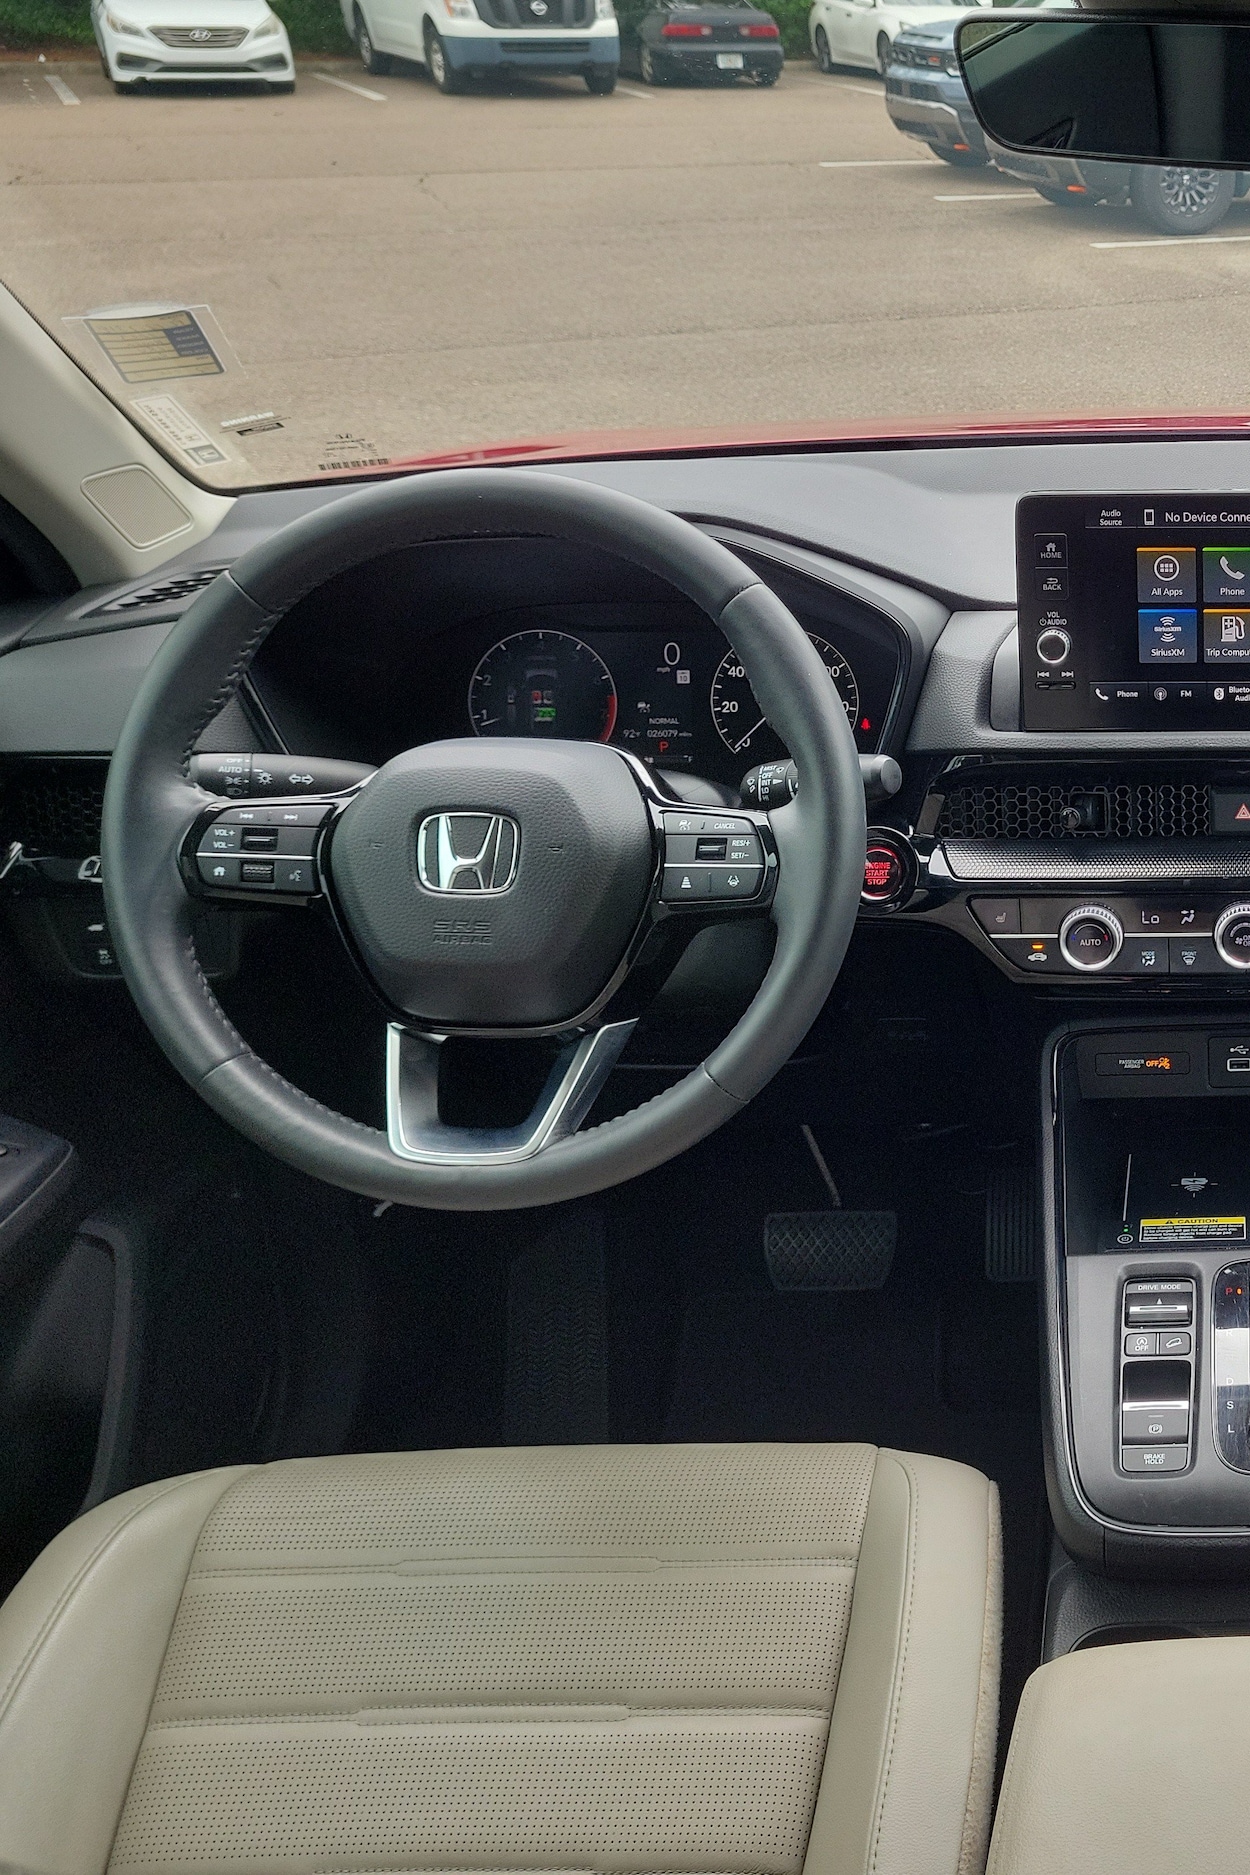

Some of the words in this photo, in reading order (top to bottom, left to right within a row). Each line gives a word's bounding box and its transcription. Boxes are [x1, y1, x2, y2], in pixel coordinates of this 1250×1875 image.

[1100, 509, 1122, 518] Audio
[1165, 512, 1179, 523] No
[1183, 512, 1217, 523] Device
[1099, 518, 1123, 526] Source
[1151, 587, 1162, 596] All
[1163, 587, 1183, 597] Apps
[1220, 587, 1245, 596] Phone
[1046, 618, 1067, 626] AUDIO
[663, 642, 680, 666] 0
[1151, 648, 1185, 657] SiriusXM
[1206, 648, 1221, 658] Trip
[727, 666, 745, 678] 40
[1116, 690, 1138, 698] Phone
[1180, 690, 1192, 698] FM
[721, 701, 739, 713] 20
[648, 717, 680, 725] NORMAL
[646, 729, 679, 738] 026079
[660, 741, 669, 753] P
[1141, 910, 1160, 924] Lo
[433, 920, 492, 933] SRS
[433, 935, 492, 946] AIRBAG
[1225, 1287, 1233, 1296] P
[1226, 1377, 1234, 1386] D
[1226, 1400, 1235, 1410] S
[1227, 1424, 1235, 1433] L
